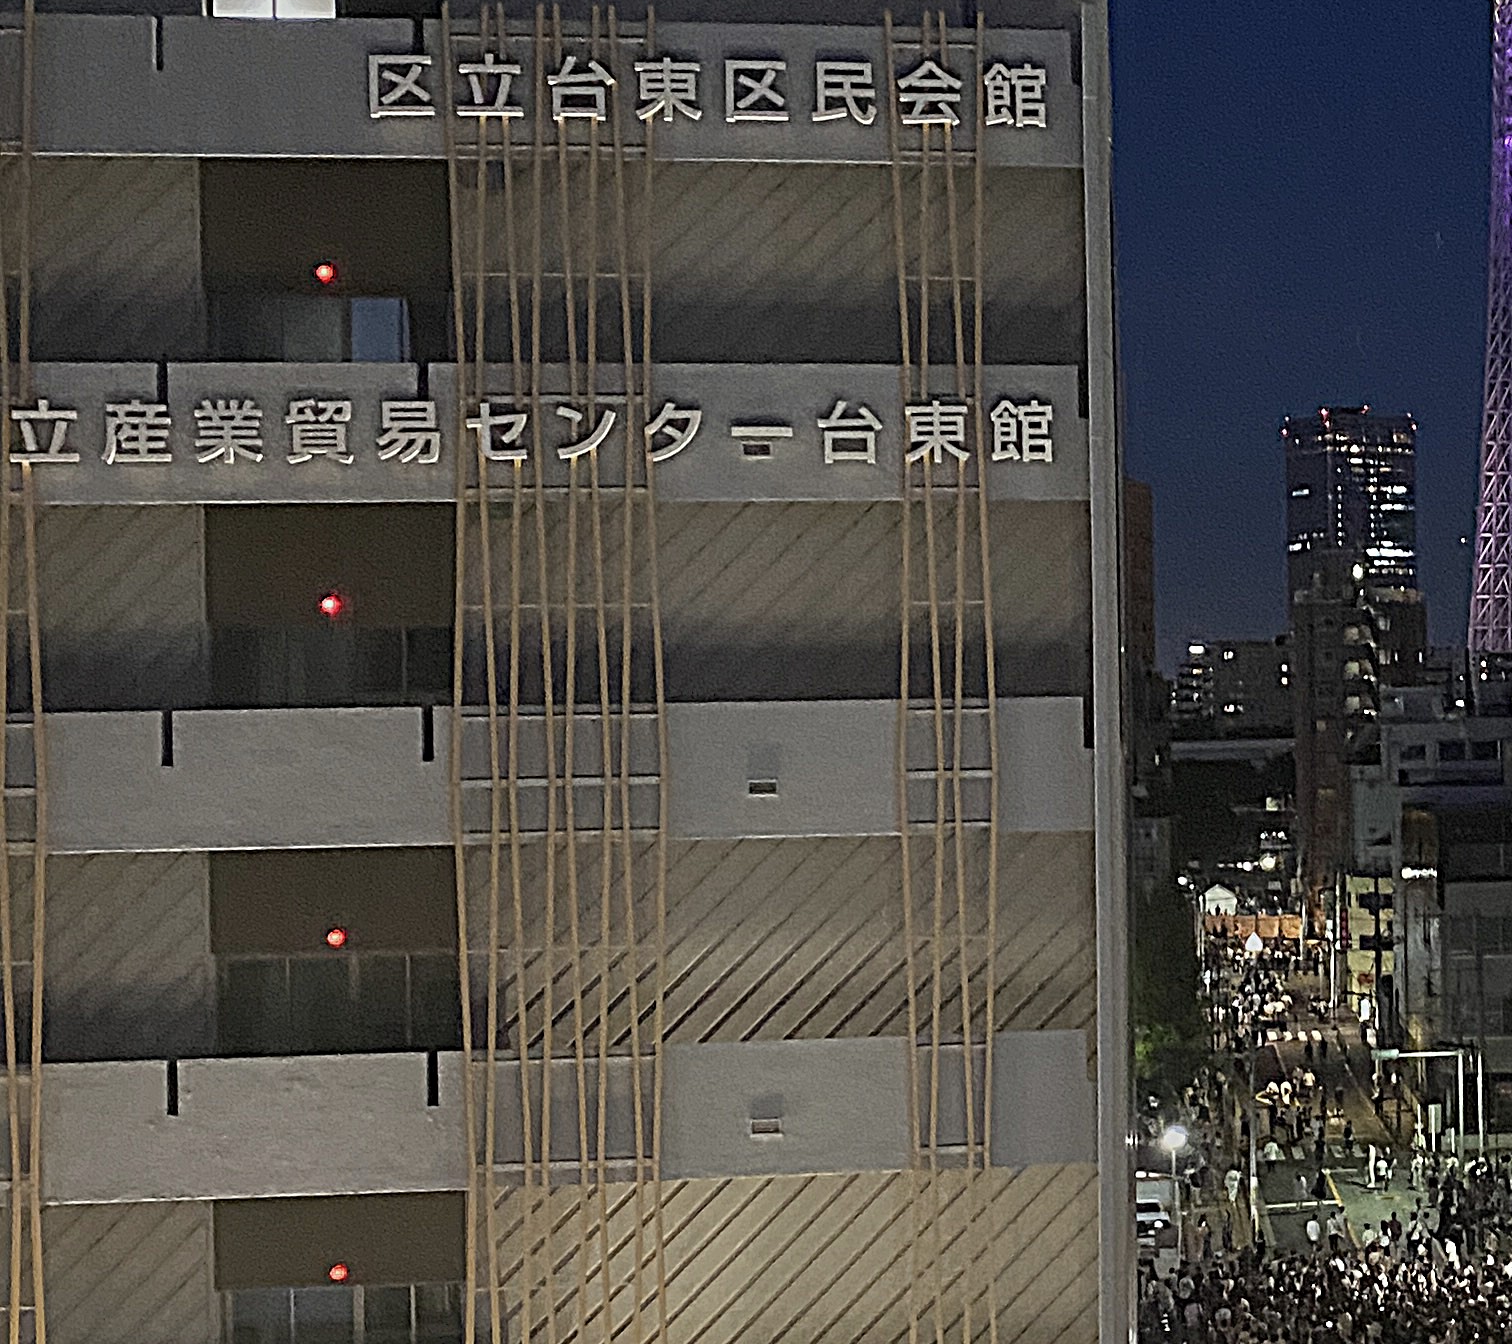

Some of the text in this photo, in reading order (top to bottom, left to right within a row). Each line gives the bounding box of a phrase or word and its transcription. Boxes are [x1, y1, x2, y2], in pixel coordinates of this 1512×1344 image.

[368, 53, 1049, 129] 区立台東区民会館
[9, 398, 1054, 467] 立産業貿易センター台東館
